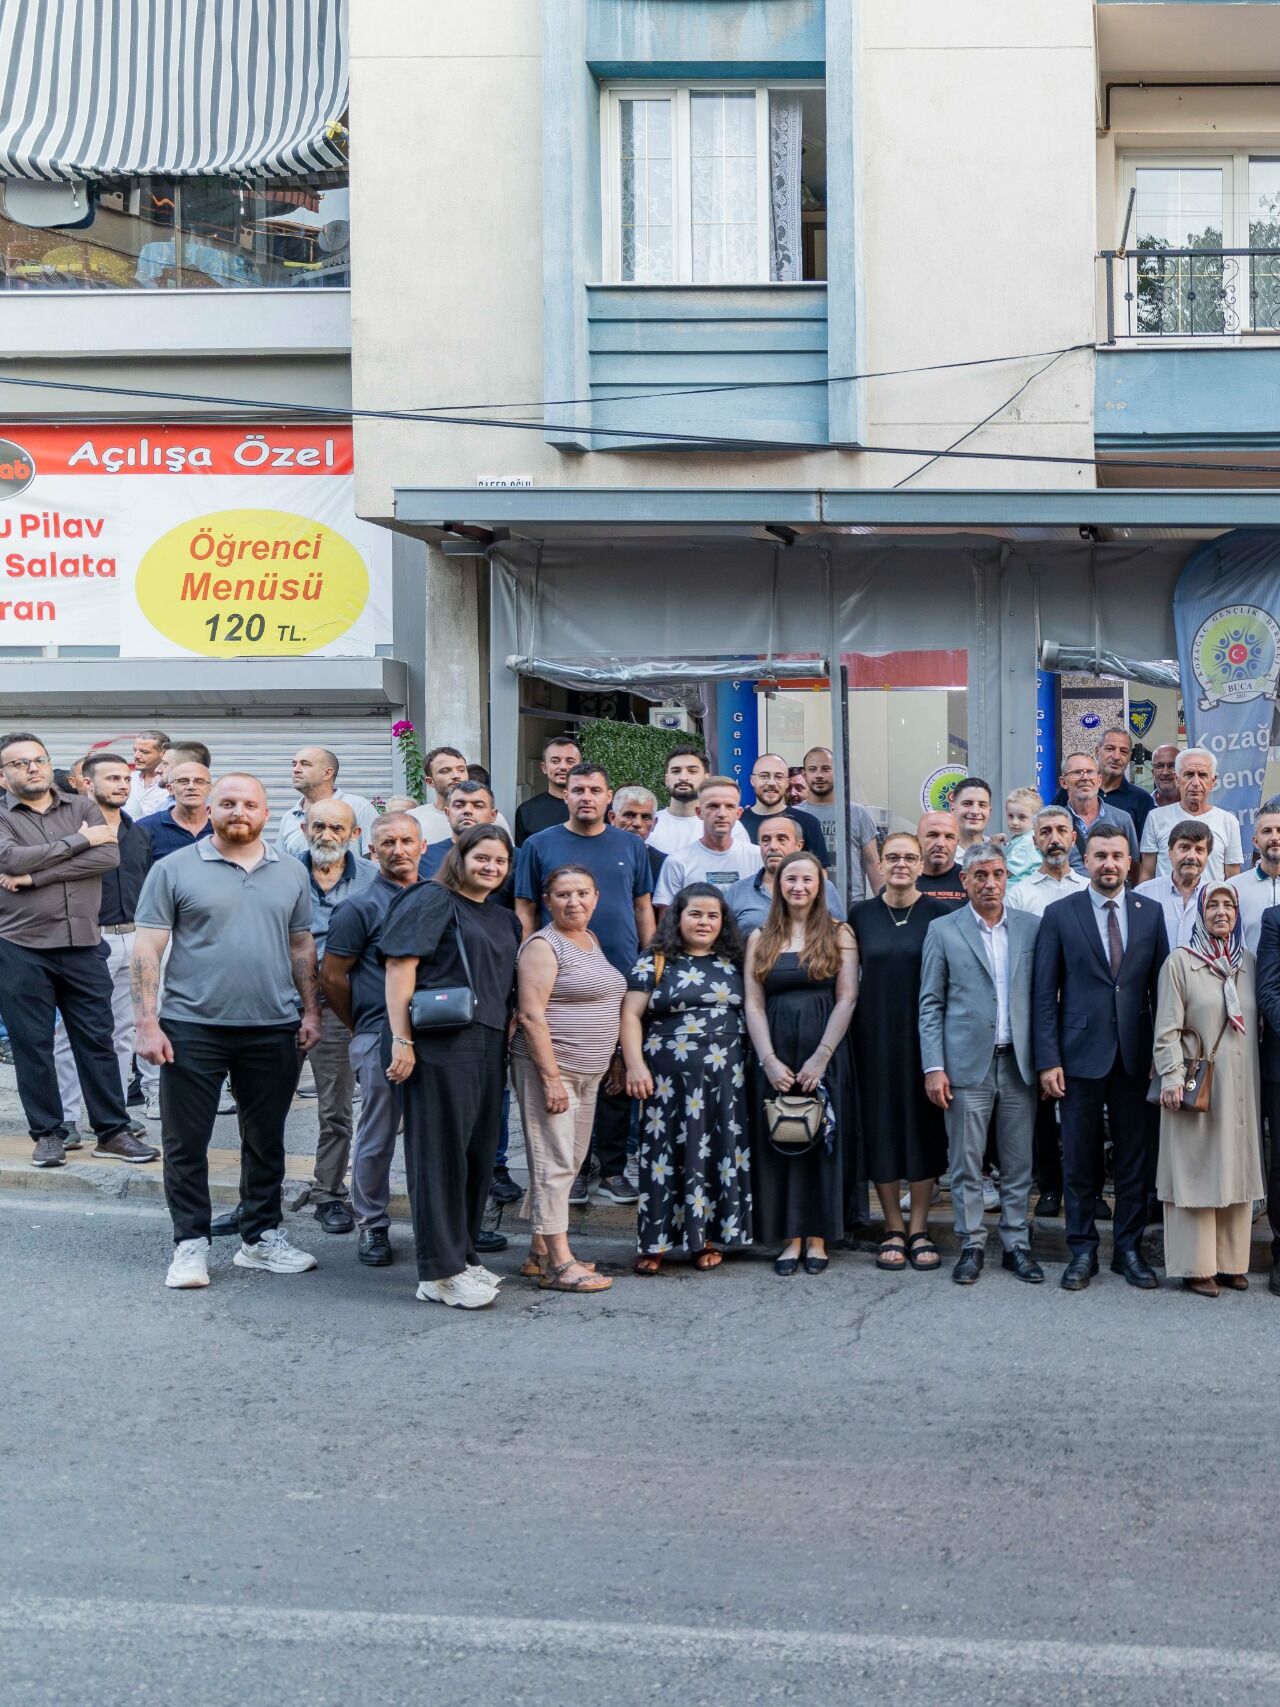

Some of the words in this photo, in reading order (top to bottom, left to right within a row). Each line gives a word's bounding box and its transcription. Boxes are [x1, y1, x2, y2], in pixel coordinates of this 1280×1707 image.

[68, 438, 213, 472] Açılışa
[233, 434, 335, 467] Özel
[20, 511, 105, 538] Pilav
[189, 527, 324, 568] Öğrenci
[5, 551, 116, 577] Salata
[180, 572, 324, 601] Menüsü
[205, 613, 266, 642] 120
[277, 625, 307, 642] TL.
